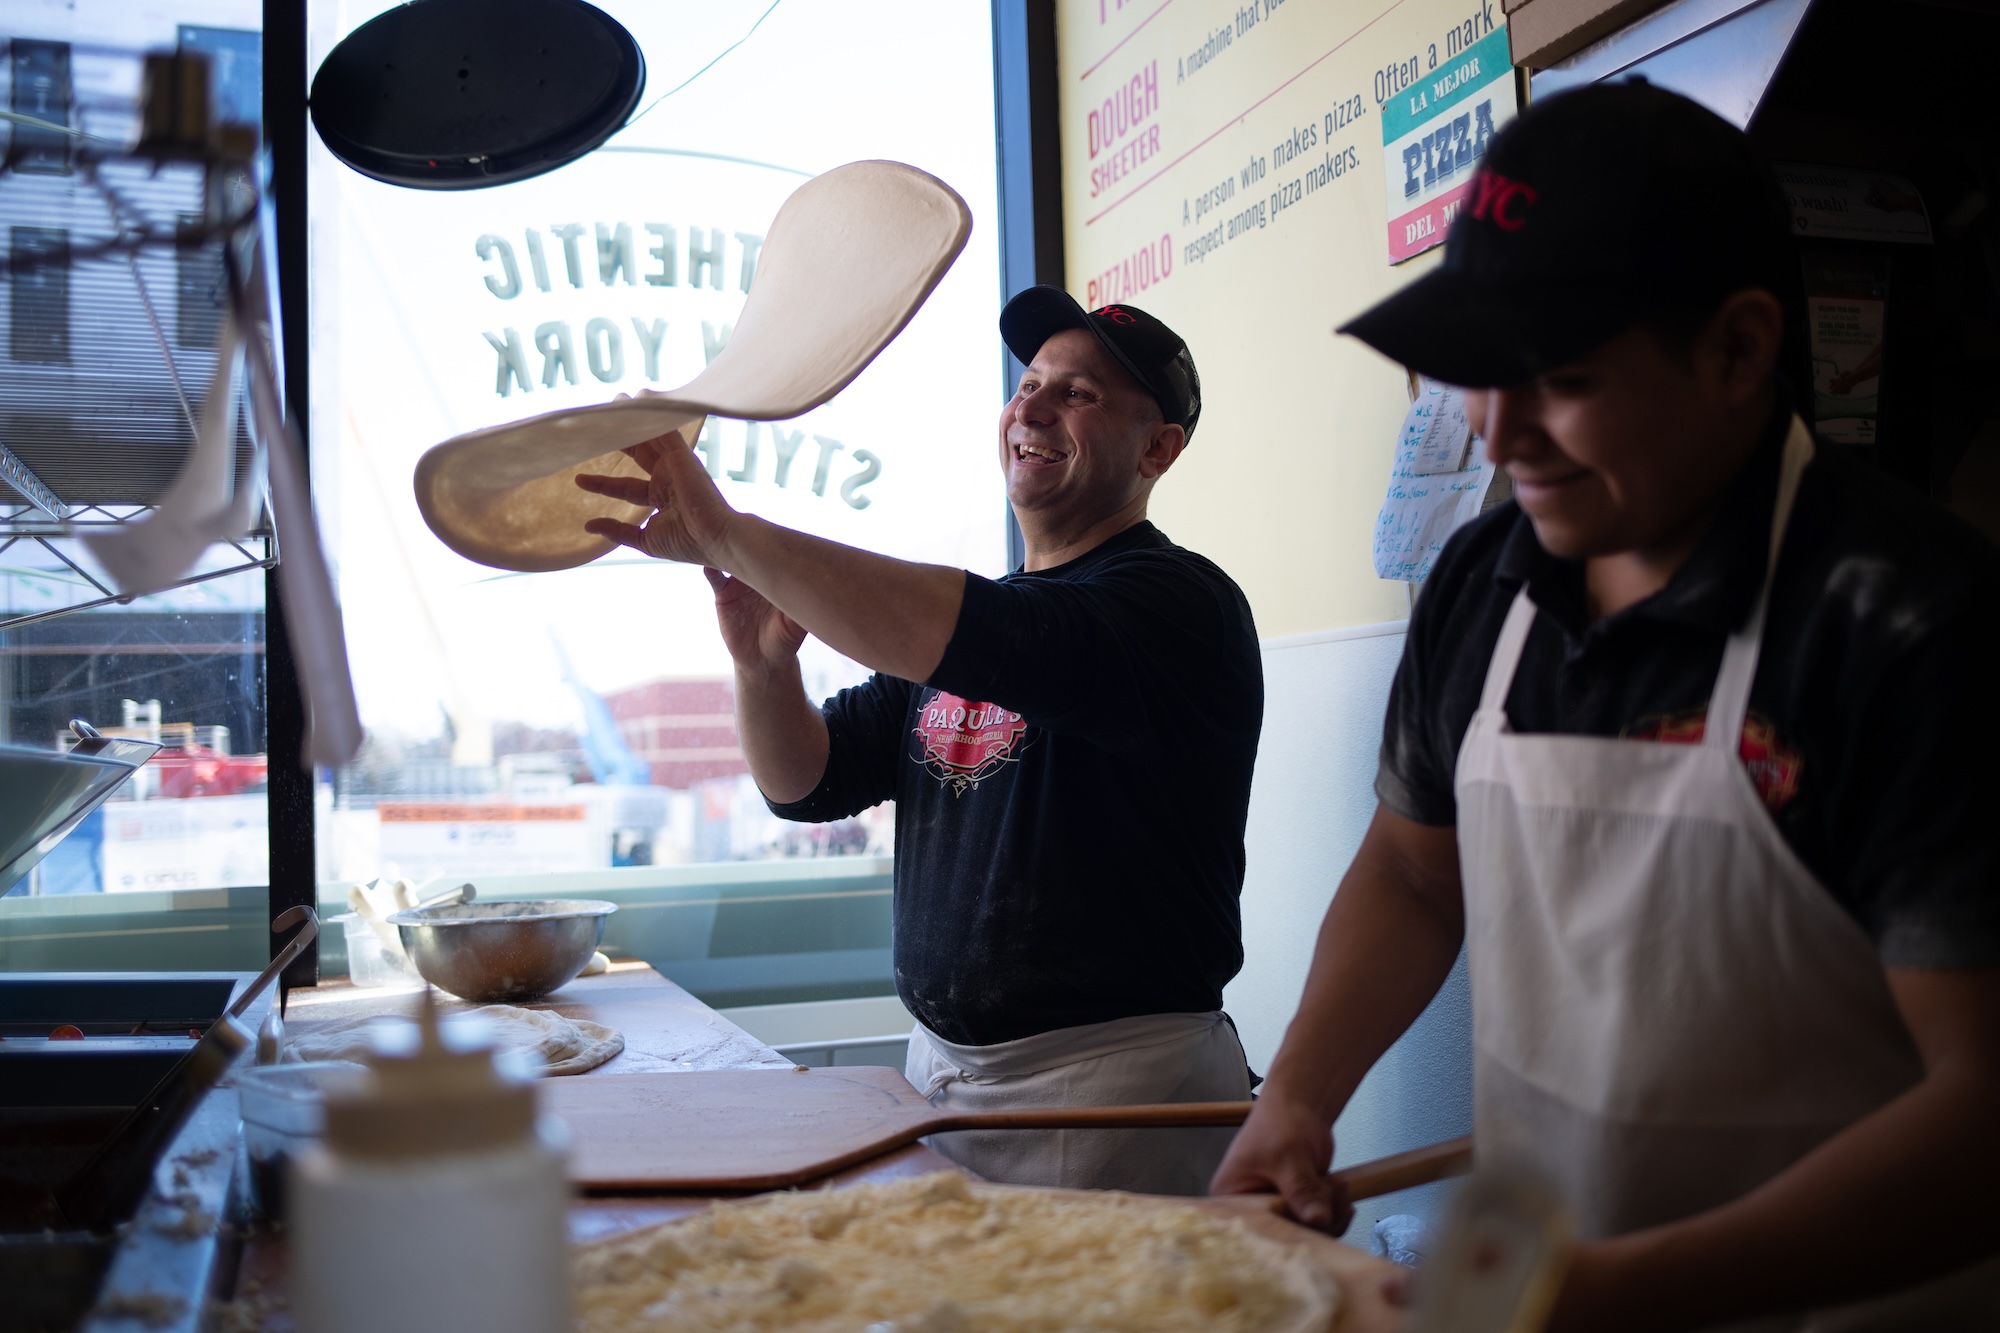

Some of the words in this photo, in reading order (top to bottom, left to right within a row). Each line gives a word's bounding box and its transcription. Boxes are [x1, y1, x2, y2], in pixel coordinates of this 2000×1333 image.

[1177, 57, 1186, 86] A
[1186, 24, 1233, 77] machine
[1235, 0, 1260, 38] that
[1088, 59, 1160, 161] DOUGH
[1182, 198, 1191, 228] A
[1194, 175, 1236, 226] person
[1240, 154, 1267, 190] who
[1273, 123, 1318, 170] makes
[1324, 93, 1368, 145] pizza.
[1373, 55, 1419, 105] Often
[1428, 43, 1438, 71] a
[1446, 0, 1495, 58] mark
[1409, 91, 1428, 117] LA
[1432, 57, 1481, 102] MEJOR
[1090, 123, 1162, 199] SHEETER
[1402, 98, 1496, 199] PIZZA
[1776, 174, 1849, 188] emember
[1184, 222, 1225, 267] respect
[1226, 199, 1267, 241] among
[1270, 178, 1302, 224] pizza
[1305, 145, 1361, 196] makers.
[1405, 213, 1436, 247] DEL
[1086, 233, 1173, 312] PIZZAIOLO
